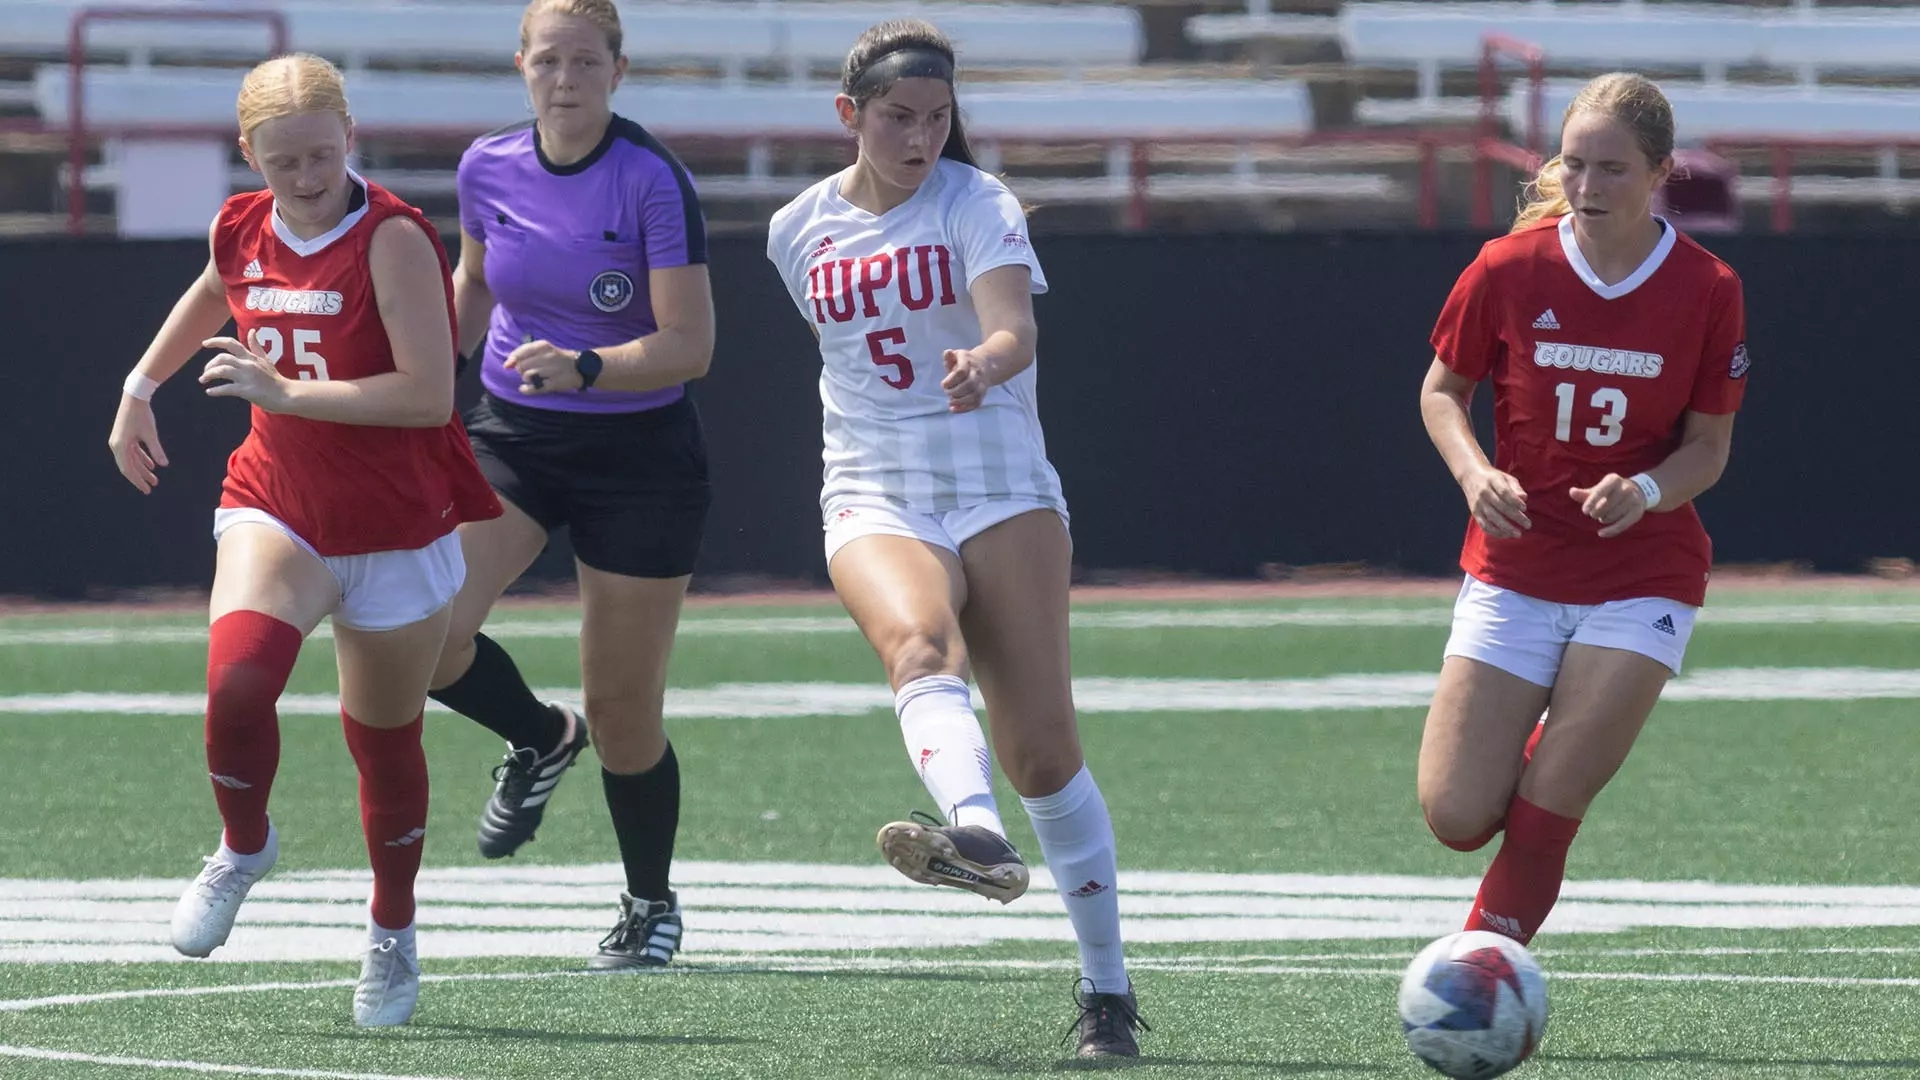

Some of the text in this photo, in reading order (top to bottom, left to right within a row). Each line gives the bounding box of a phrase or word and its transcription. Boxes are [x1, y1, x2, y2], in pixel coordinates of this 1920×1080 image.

[245, 286, 344, 316] COUGARS
[808, 244, 957, 325] IUPUI
[254, 326, 330, 381] 25
[865, 326, 915, 390] 5
[1533, 341, 1665, 379] COUGARS
[1554, 381, 1628, 447] 13
